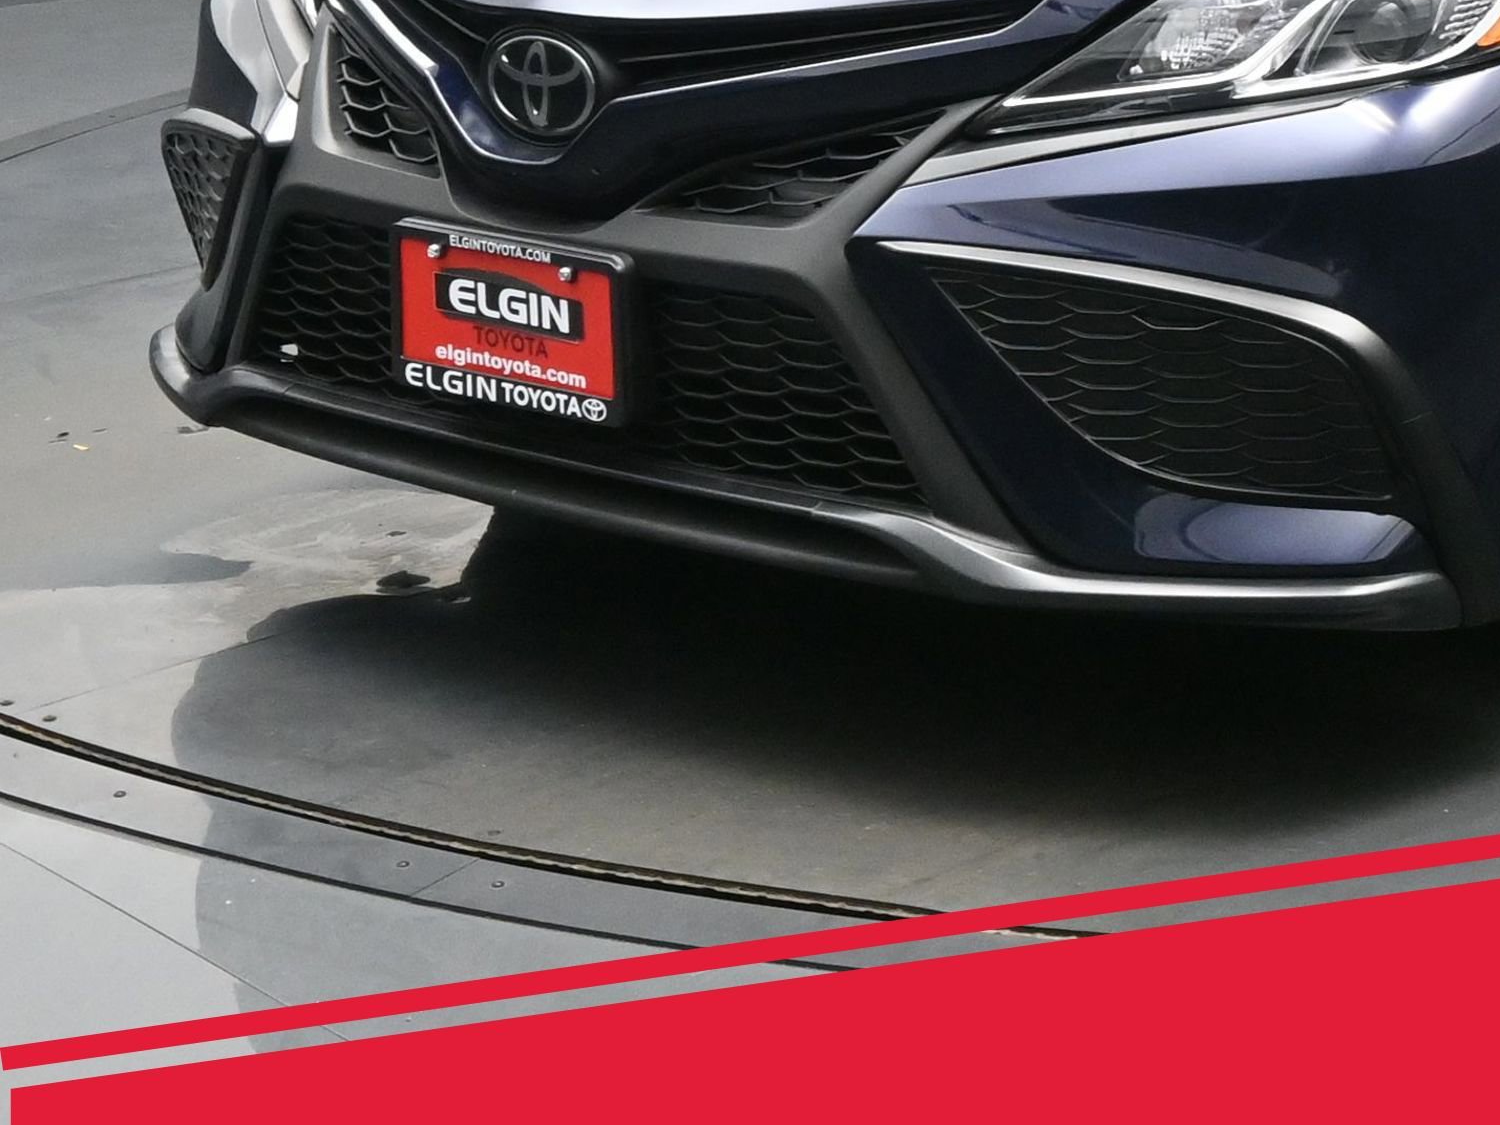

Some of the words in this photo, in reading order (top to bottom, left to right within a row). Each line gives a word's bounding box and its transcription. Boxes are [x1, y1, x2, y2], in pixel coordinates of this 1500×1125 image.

[449, 235, 551, 263] ELGINTOYOTA.COM
[448, 278, 570, 334] ELGIN
[474, 327, 548, 358] TOYOTA
[435, 345, 587, 388] elgintoyota.com
[404, 362, 497, 403] ELGIN
[501, 383, 583, 418] TOYOTA
